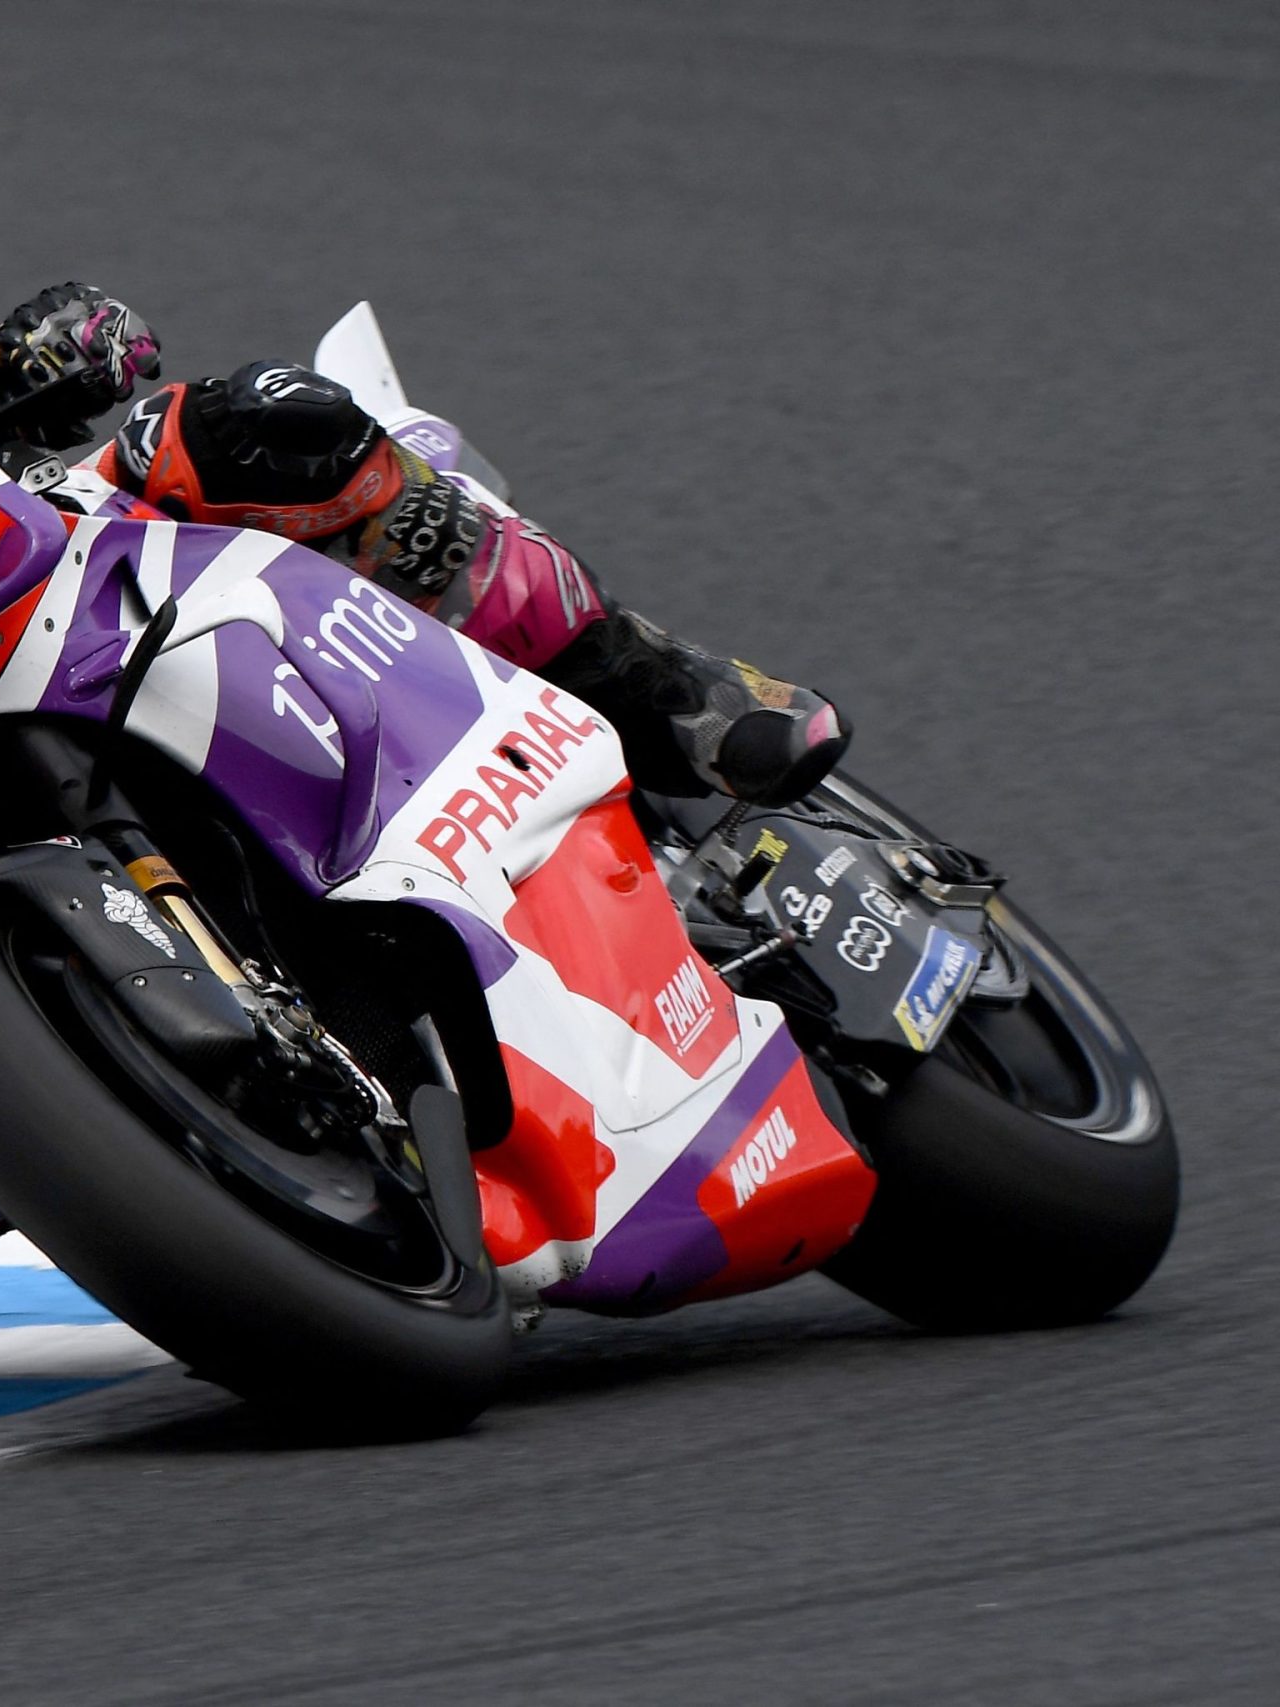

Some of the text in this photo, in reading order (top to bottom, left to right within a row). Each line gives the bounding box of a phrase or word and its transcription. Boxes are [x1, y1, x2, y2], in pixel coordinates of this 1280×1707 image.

[388, 484, 426, 539] ANTI
[391, 481, 452, 570] SOCIAL
[415, 687, 597, 885] PRAMAC
[654, 956, 712, 1045] FIAMM
[730, 1106, 797, 1209] MOTUL
